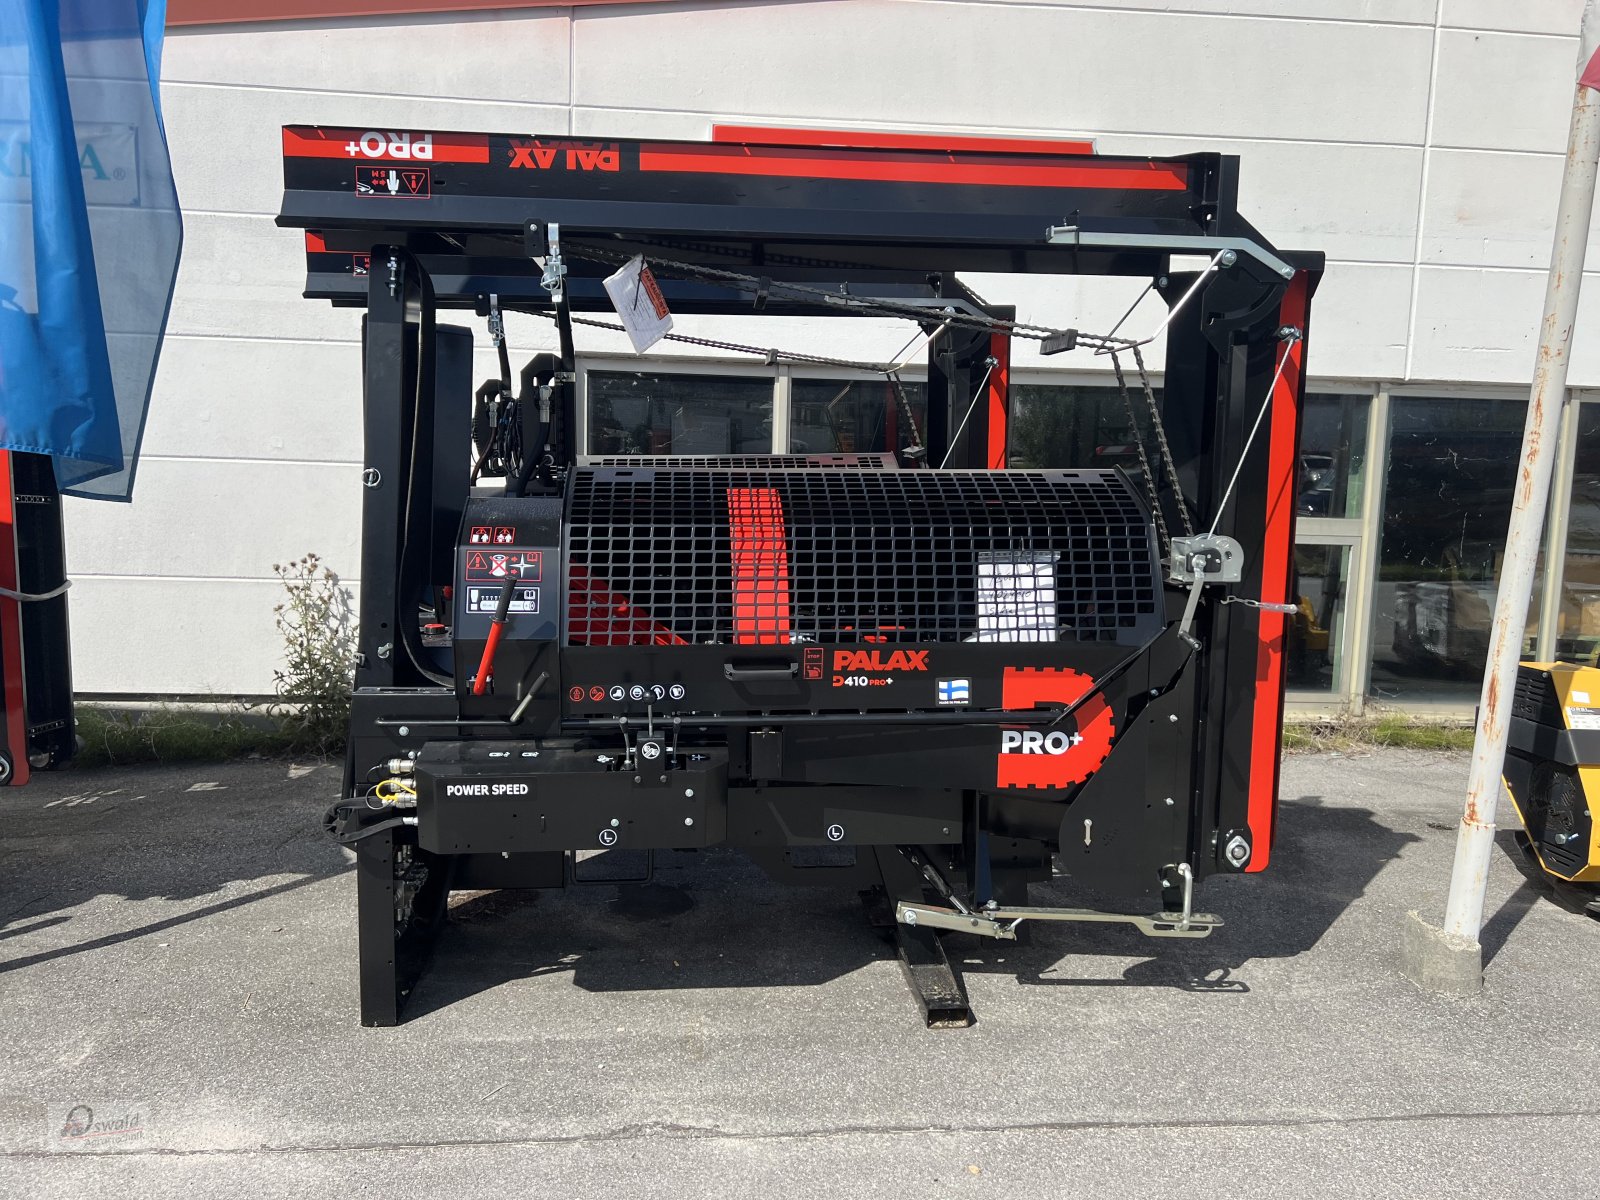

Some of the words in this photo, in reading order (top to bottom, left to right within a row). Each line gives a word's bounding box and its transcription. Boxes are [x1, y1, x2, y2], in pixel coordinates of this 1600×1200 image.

[345, 131, 433, 159] PRO+
[508, 139, 620, 172] PALAX
[833, 650, 929, 671] PALAX
[1001, 730, 1083, 755] PRO+
[446, 784, 490, 796] POWER
[491, 783, 529, 795] SPEED
